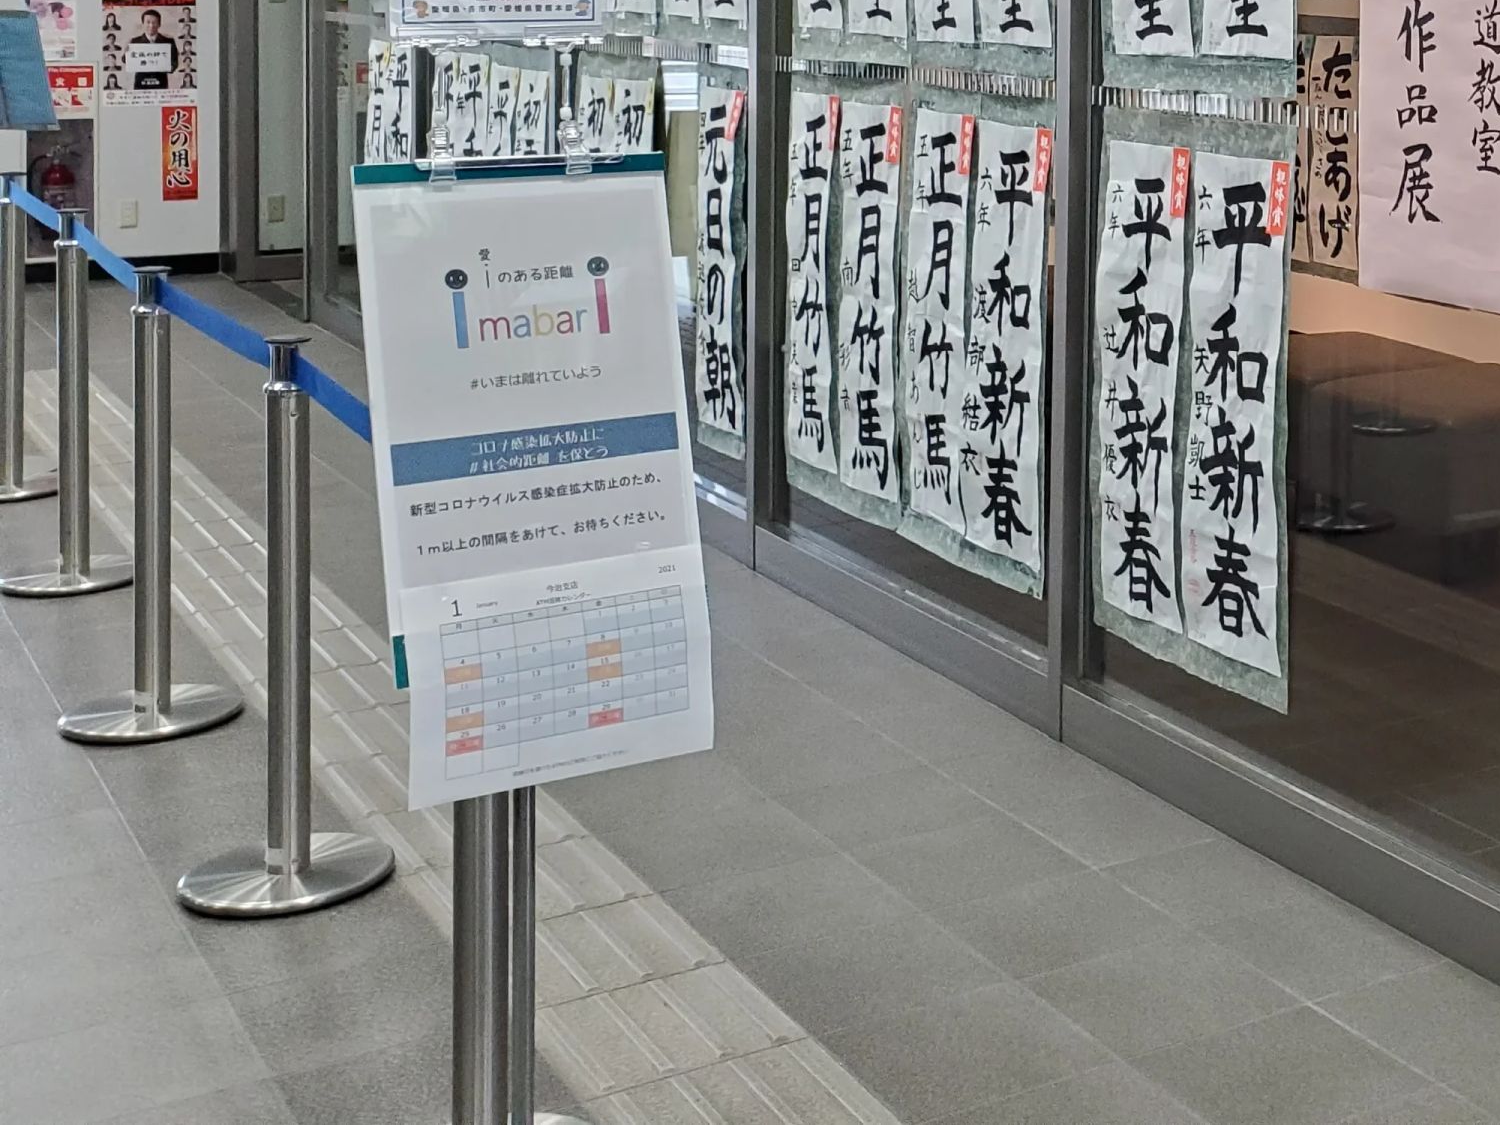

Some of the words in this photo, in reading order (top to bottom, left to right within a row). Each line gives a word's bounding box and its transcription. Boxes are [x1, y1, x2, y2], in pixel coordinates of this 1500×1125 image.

[166, 108, 192, 188] 火の用心
[704, 105, 736, 430] 元日の朝
[796, 115, 828, 453] 正月竹馬
[851, 122, 889, 491] 正月竹馬
[469, 365, 602, 391] #いまは離れていよう
[919, 132, 962, 505] 正月竹馬
[981, 150, 1033, 548] 平和新春
[1114, 177, 1171, 614] 平和新春
[1200, 181, 1271, 639] 平和新春
[409, 472, 663, 518] 新型コロナウイルス感染症拡大防止のため、
[450, 598, 463, 618] 1
